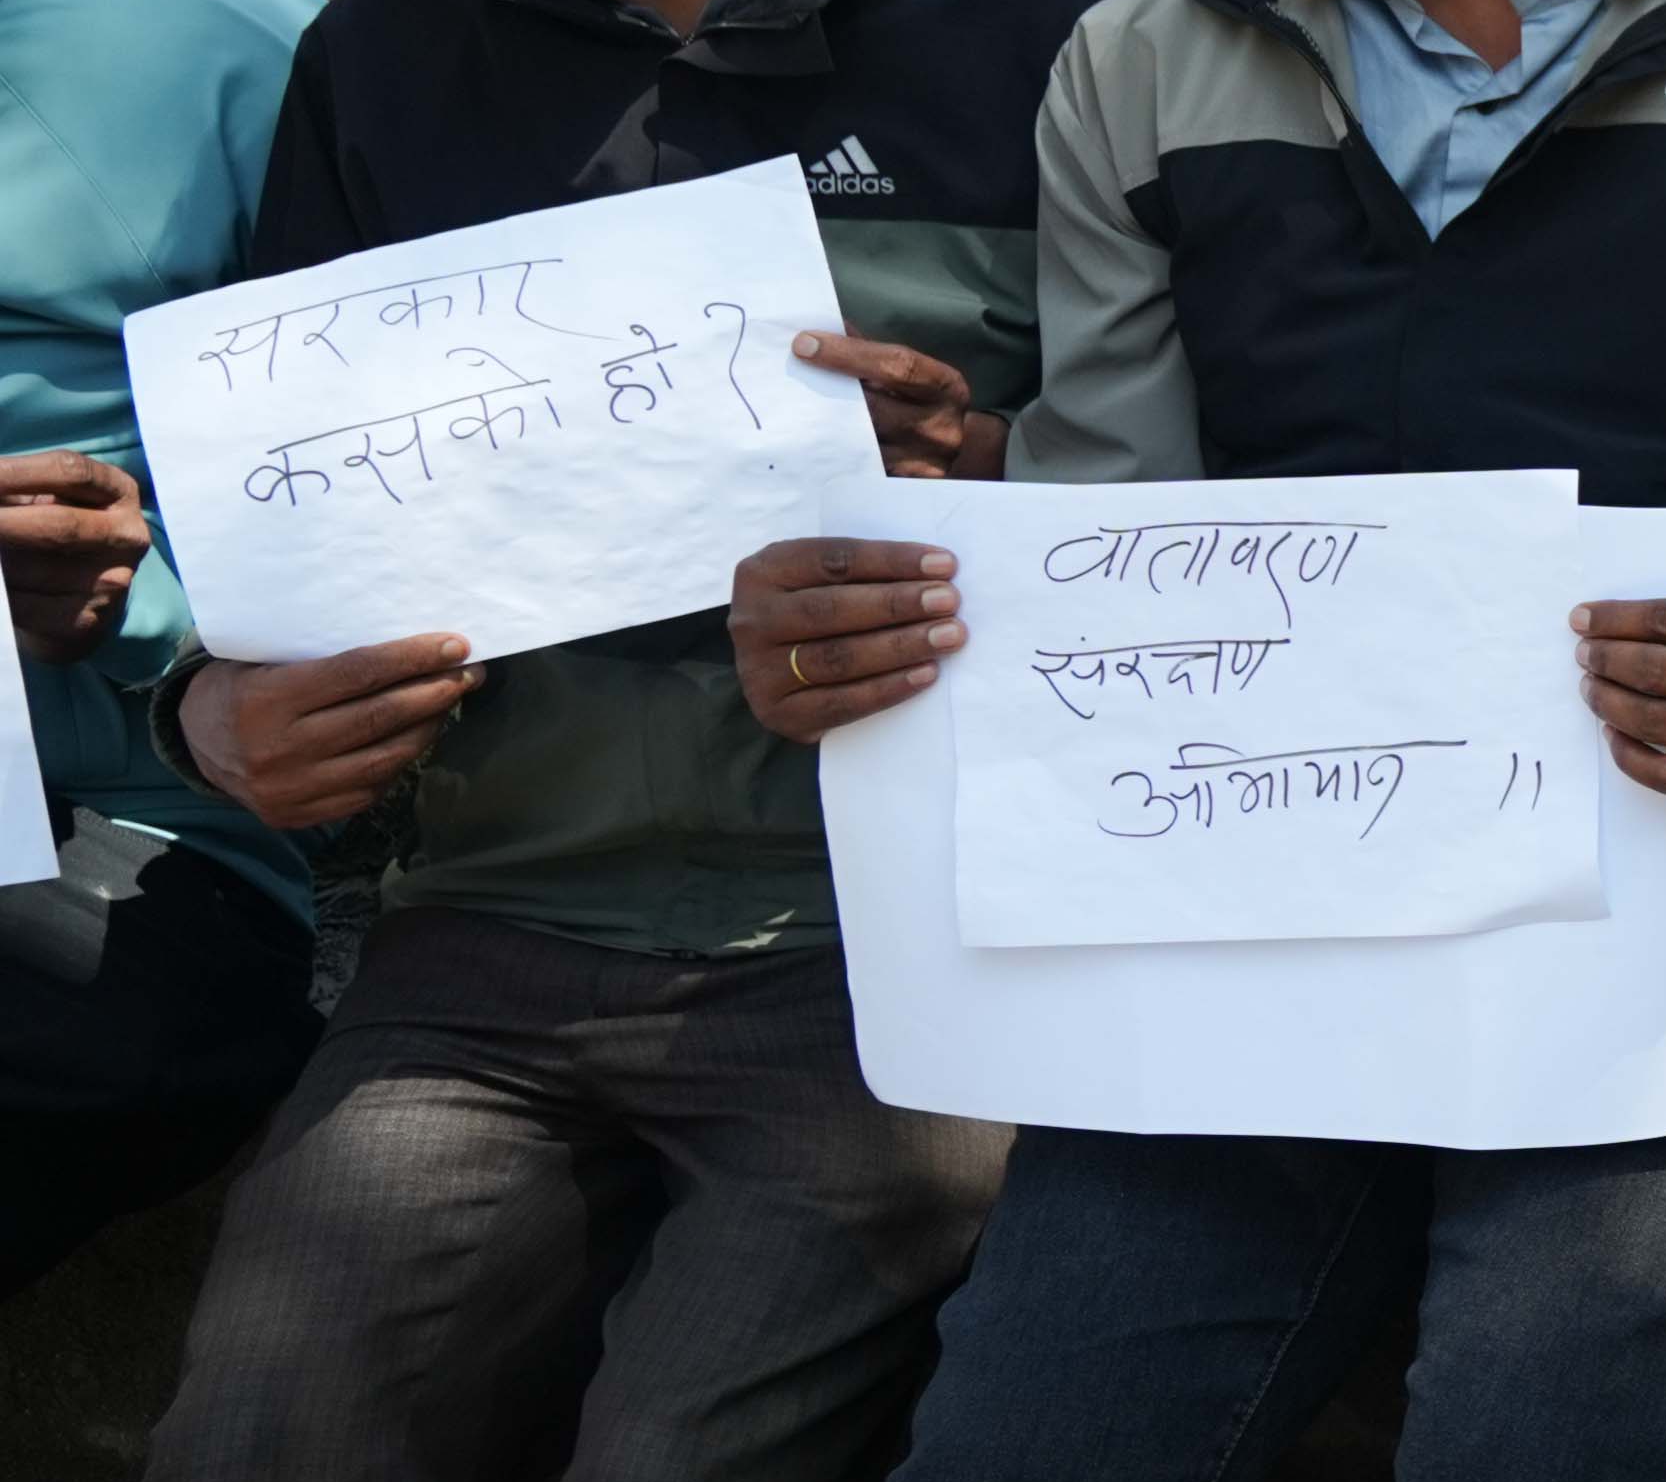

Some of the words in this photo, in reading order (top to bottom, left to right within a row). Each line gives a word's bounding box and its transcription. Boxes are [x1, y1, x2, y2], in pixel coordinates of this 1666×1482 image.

[198, 259, 622, 390] सरकार
[244, 349, 561, 505] कसको
[1044, 523, 1387, 629] वातावरण
